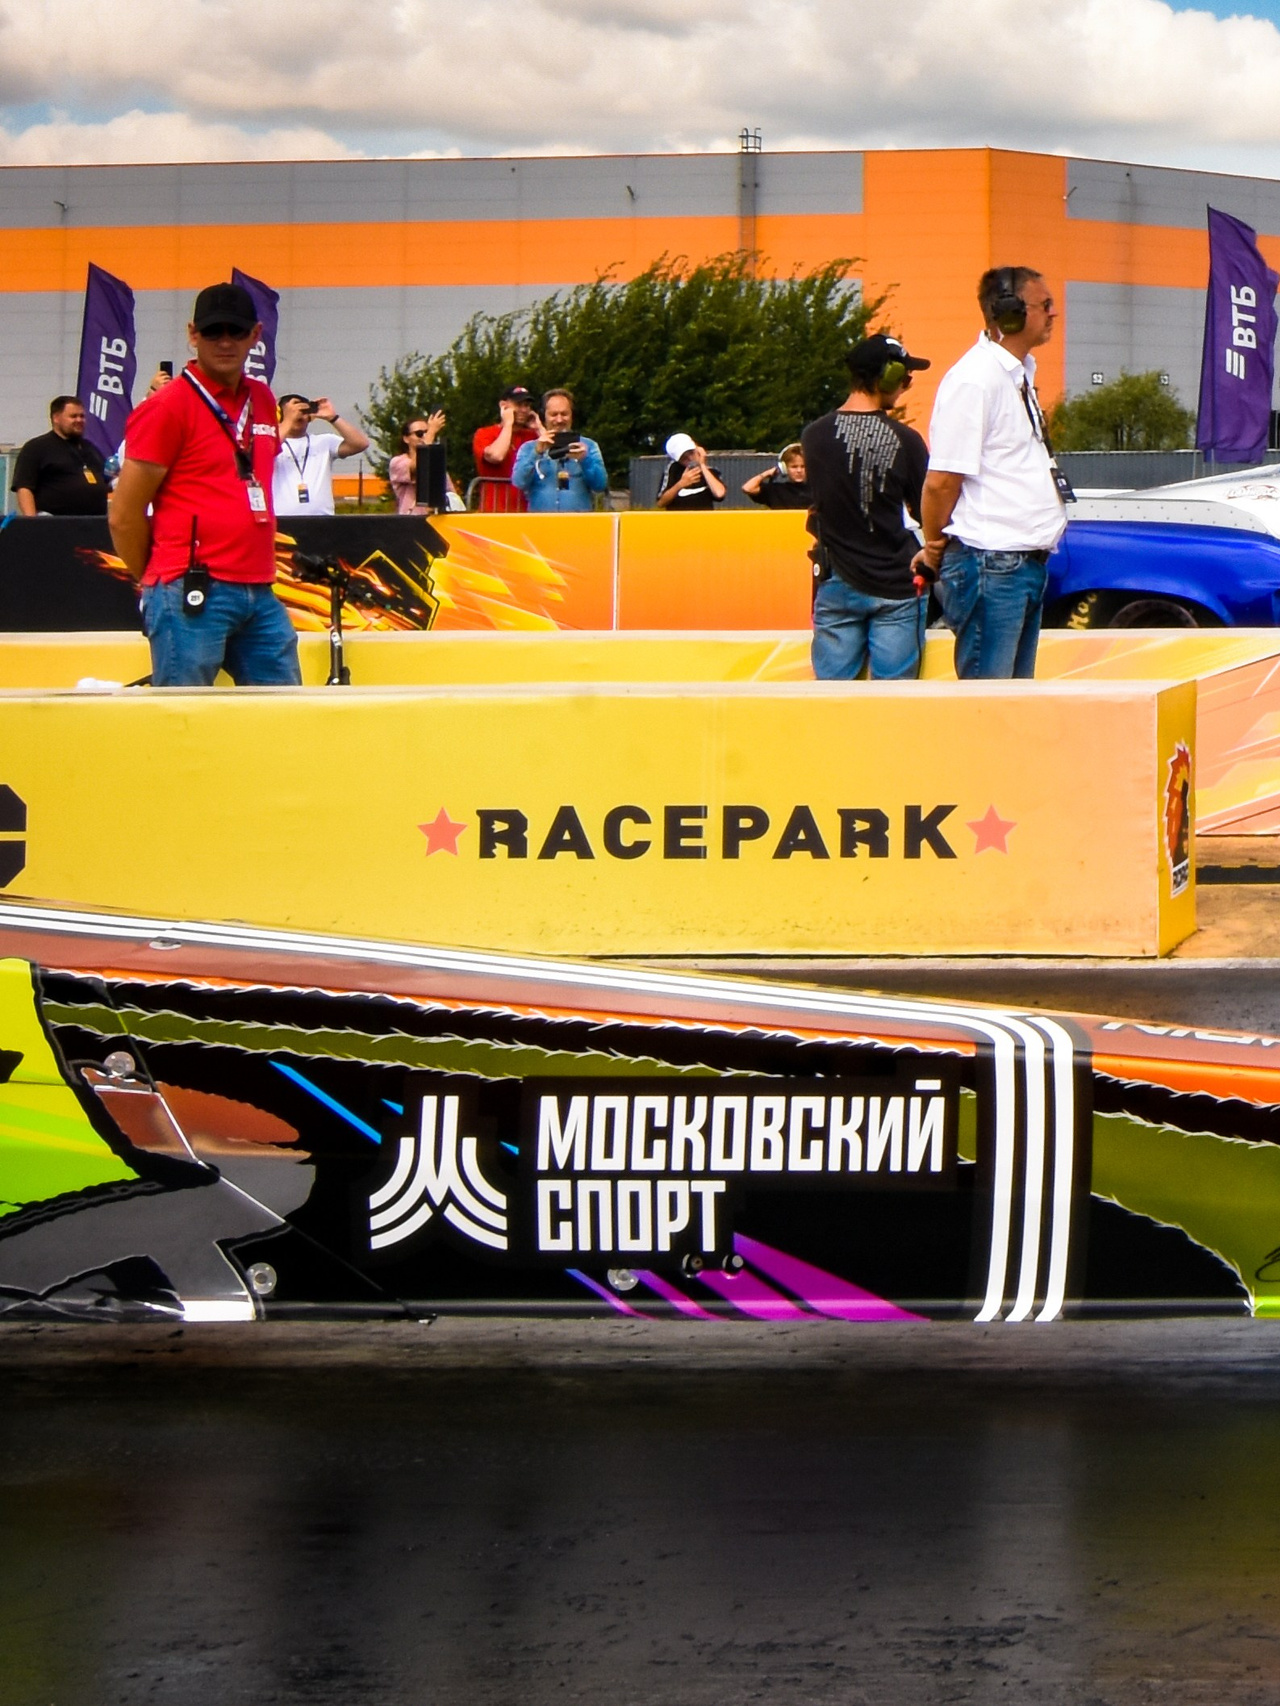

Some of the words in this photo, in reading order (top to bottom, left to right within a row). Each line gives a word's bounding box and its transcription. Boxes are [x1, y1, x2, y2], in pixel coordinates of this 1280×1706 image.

[1231, 285, 1257, 350] ВТБ
[97, 336, 128, 395] ВТБ
[476, 805, 959, 860] RACEPARK
[537, 1079, 945, 1172] МОСКОВСКИЙ
[537, 1179, 727, 1252] СПОРТ
